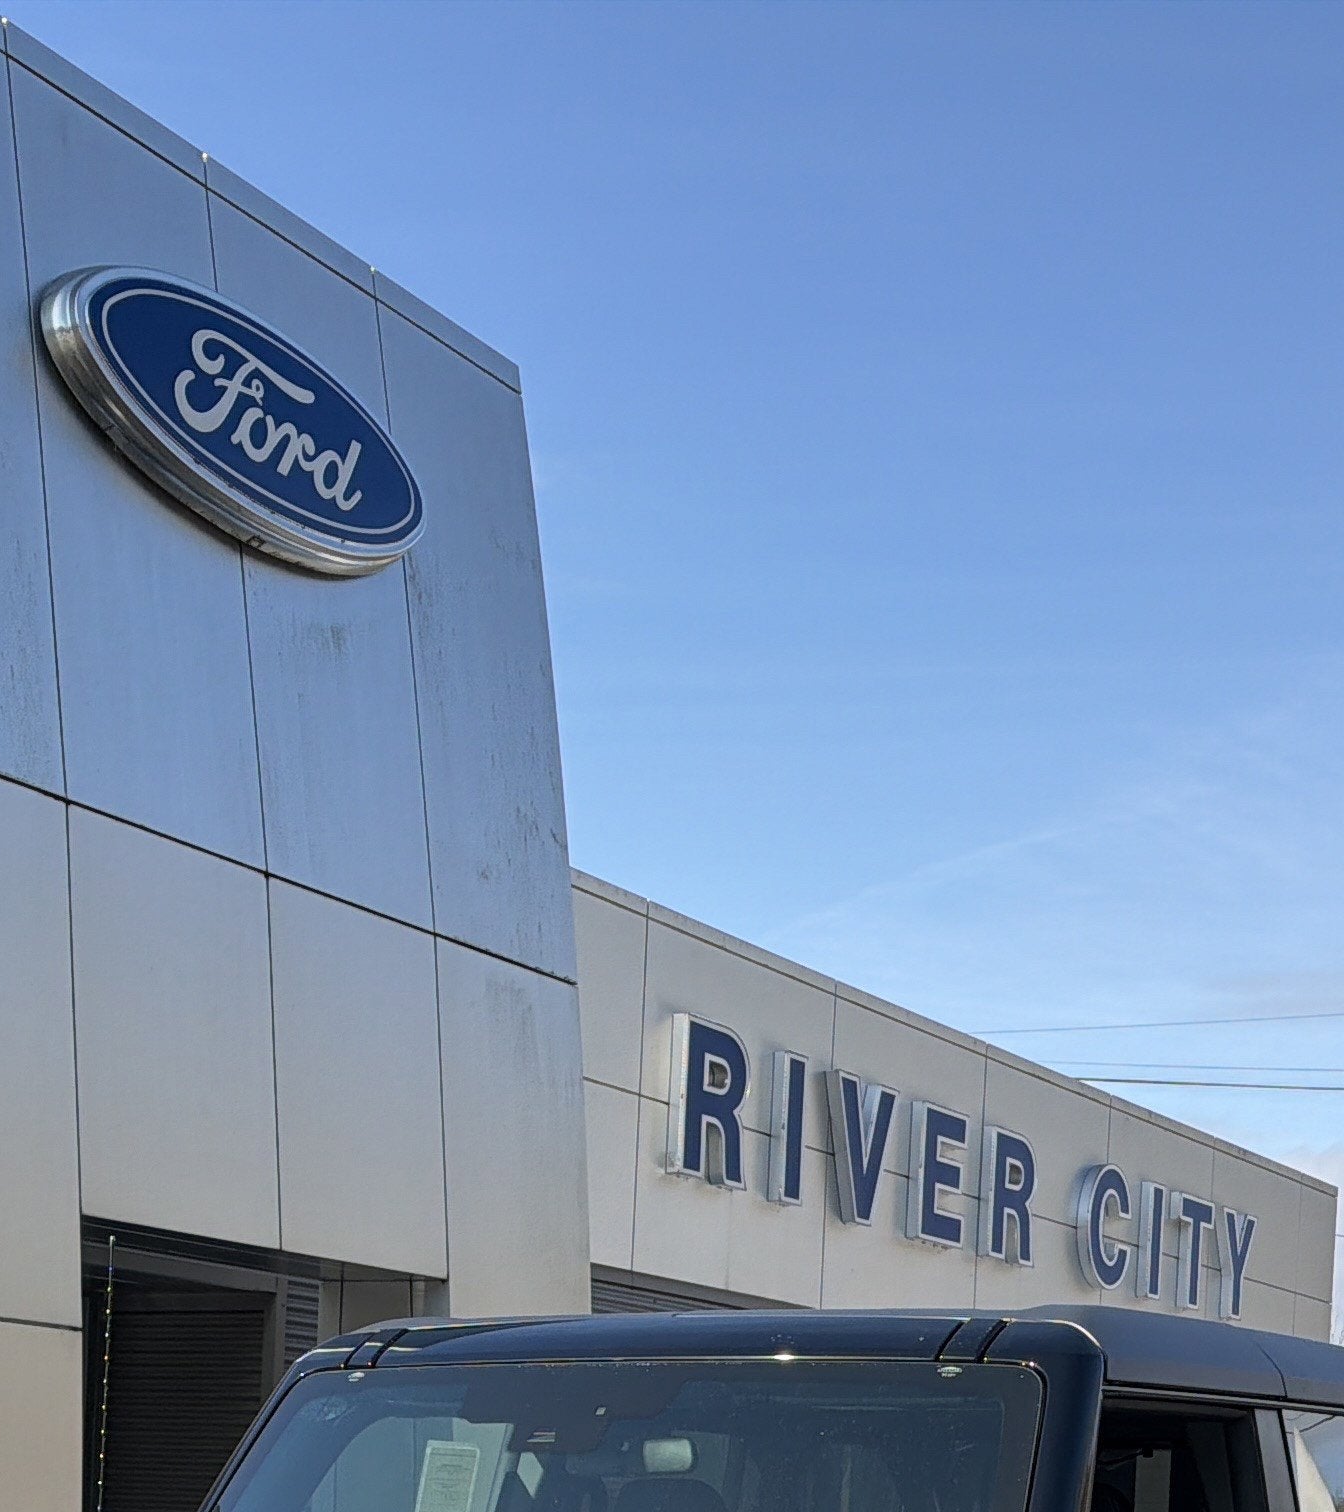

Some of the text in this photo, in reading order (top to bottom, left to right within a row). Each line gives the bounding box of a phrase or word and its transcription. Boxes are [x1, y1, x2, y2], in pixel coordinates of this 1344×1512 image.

[173, 328, 363, 511] Ford
[666, 1011, 1258, 1320] RIVER CITY
